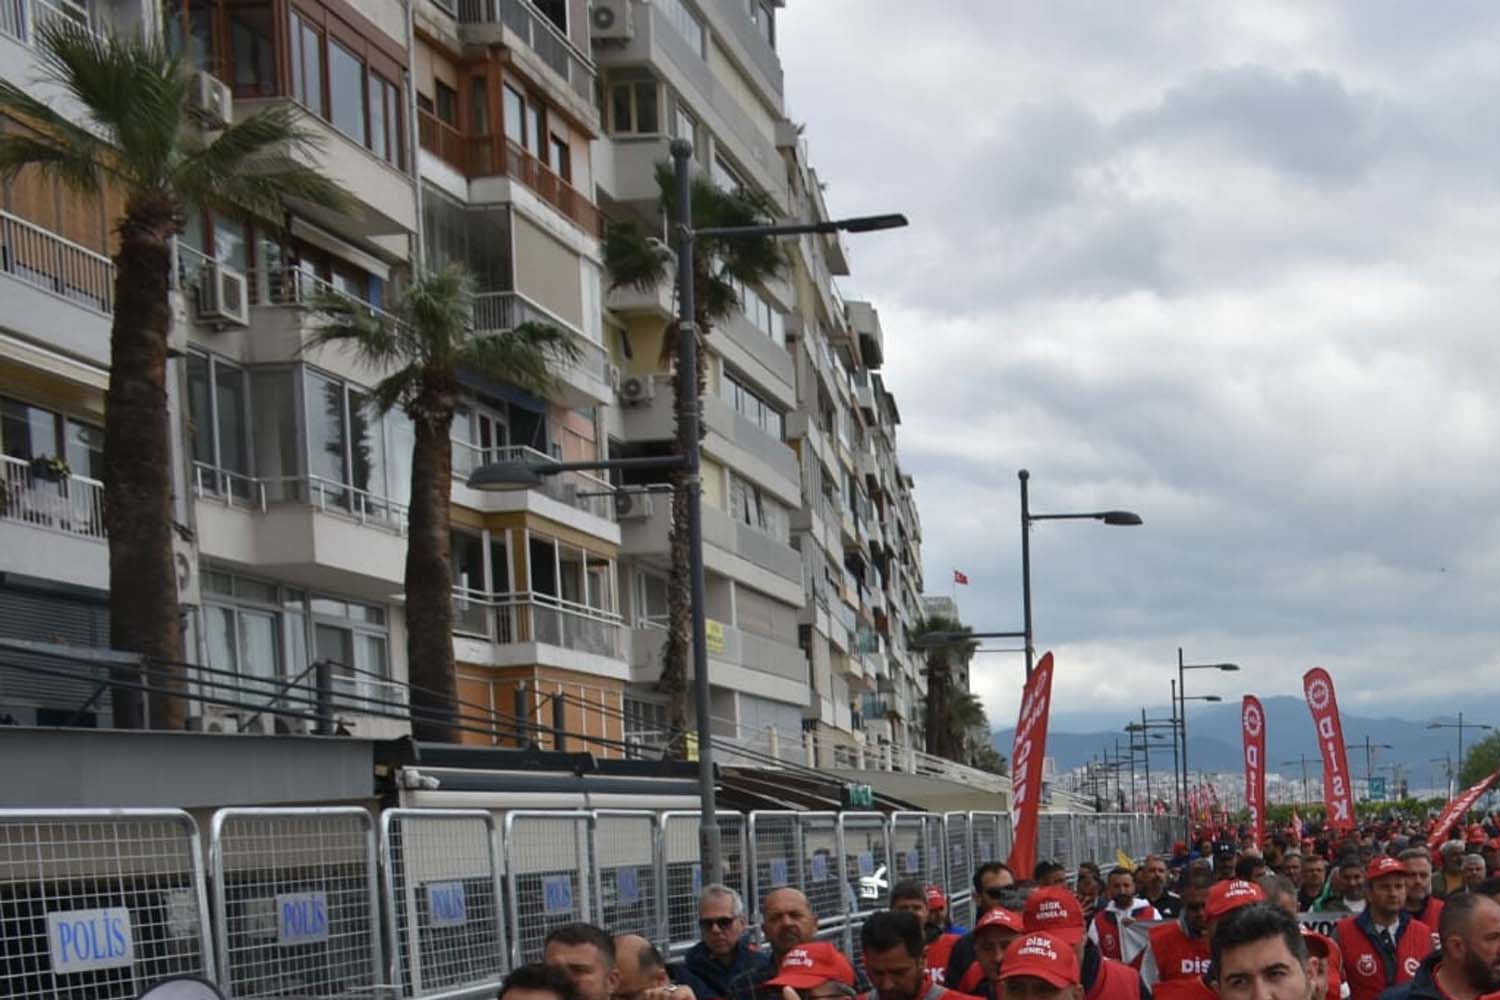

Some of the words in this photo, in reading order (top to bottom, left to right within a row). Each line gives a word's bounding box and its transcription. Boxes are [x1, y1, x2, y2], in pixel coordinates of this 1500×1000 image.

[58, 911, 127, 963] POLİS
[284, 895, 325, 938] POLİS
[1181, 956, 1212, 974] DİS
